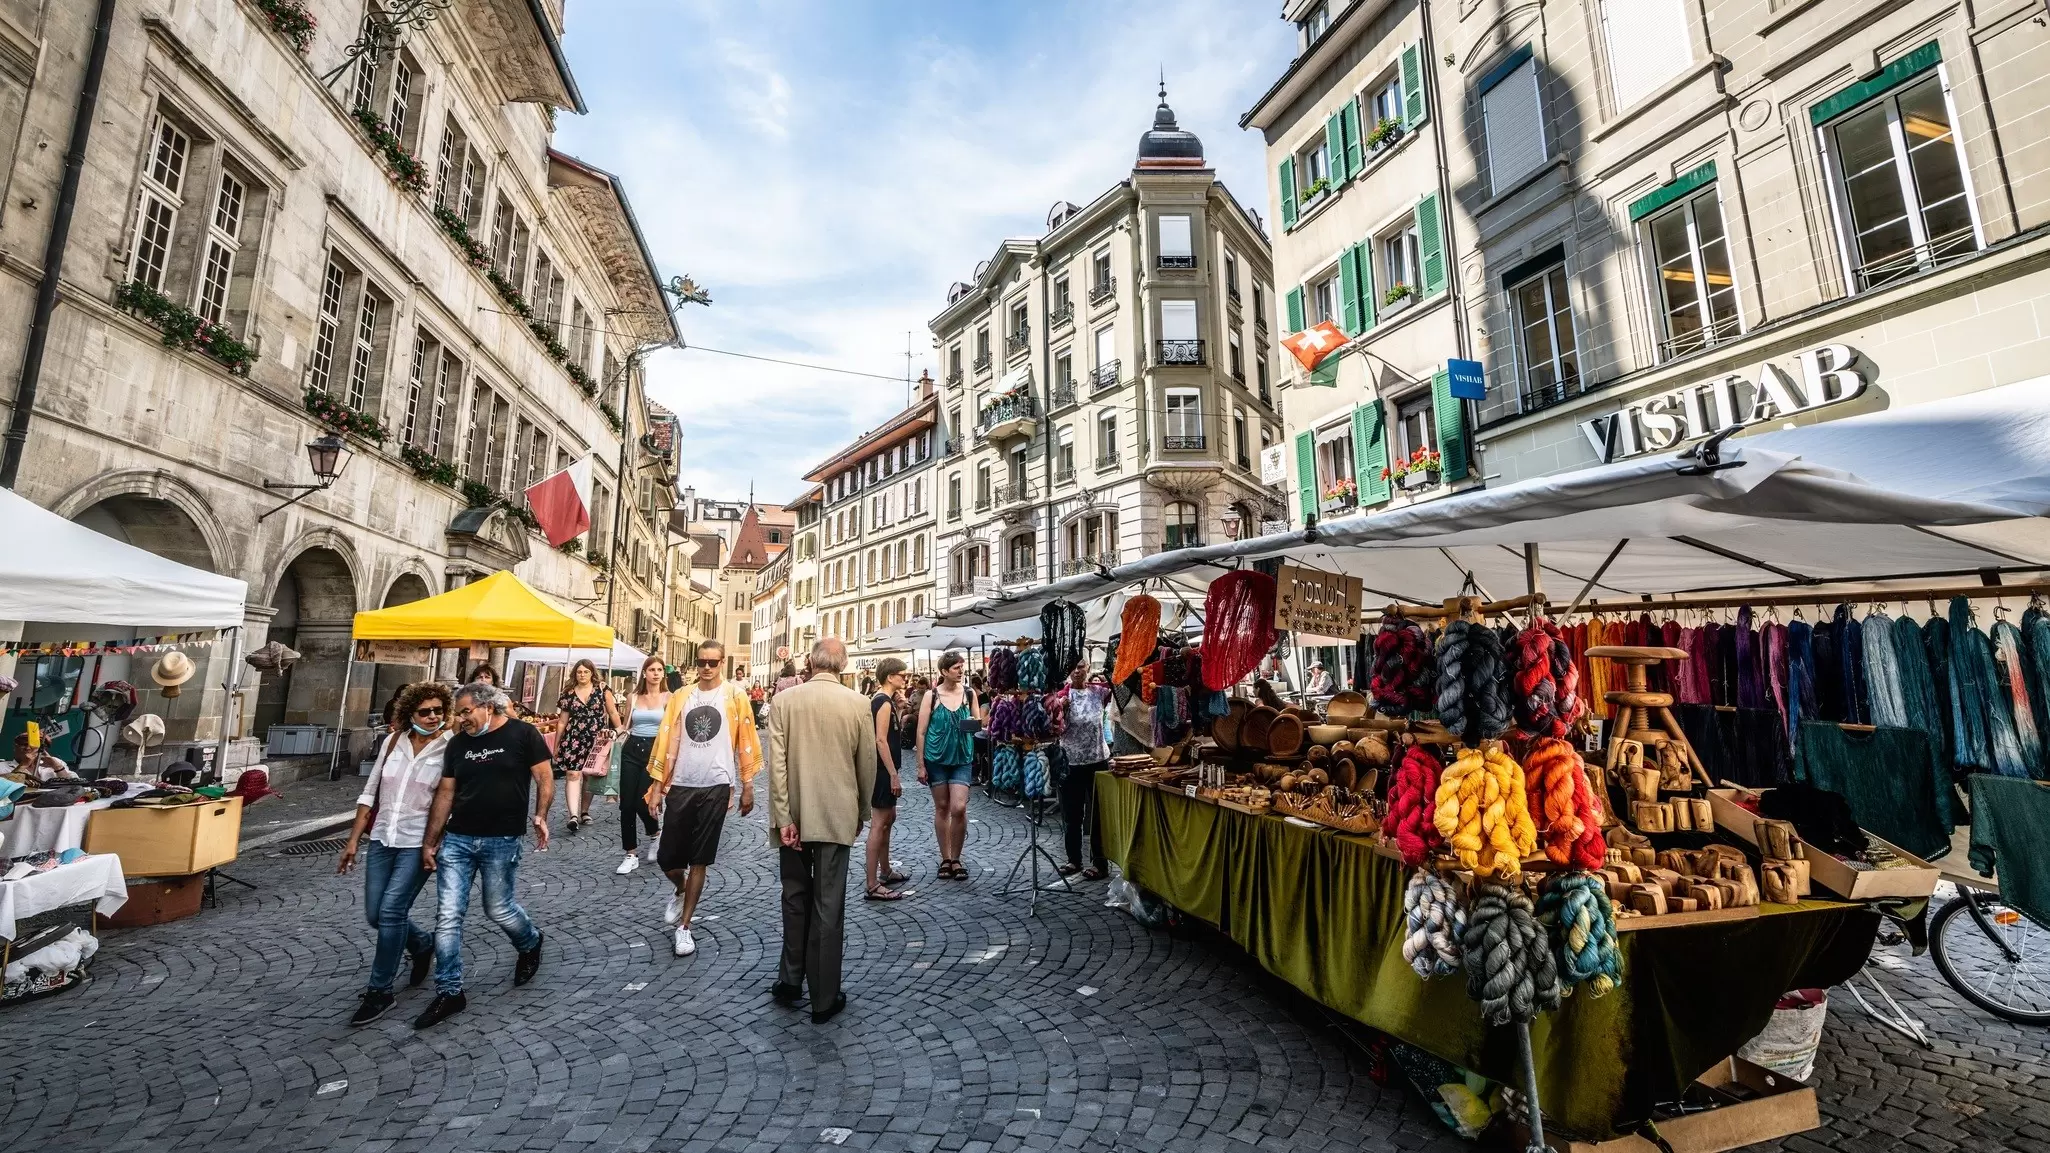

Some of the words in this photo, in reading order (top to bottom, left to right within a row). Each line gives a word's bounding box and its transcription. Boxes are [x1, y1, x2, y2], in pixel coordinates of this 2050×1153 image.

[1454, 374, 1483, 384] VISILAB
[1577, 343, 1868, 464] VISILAB
[465, 750, 482, 760] Pepe
